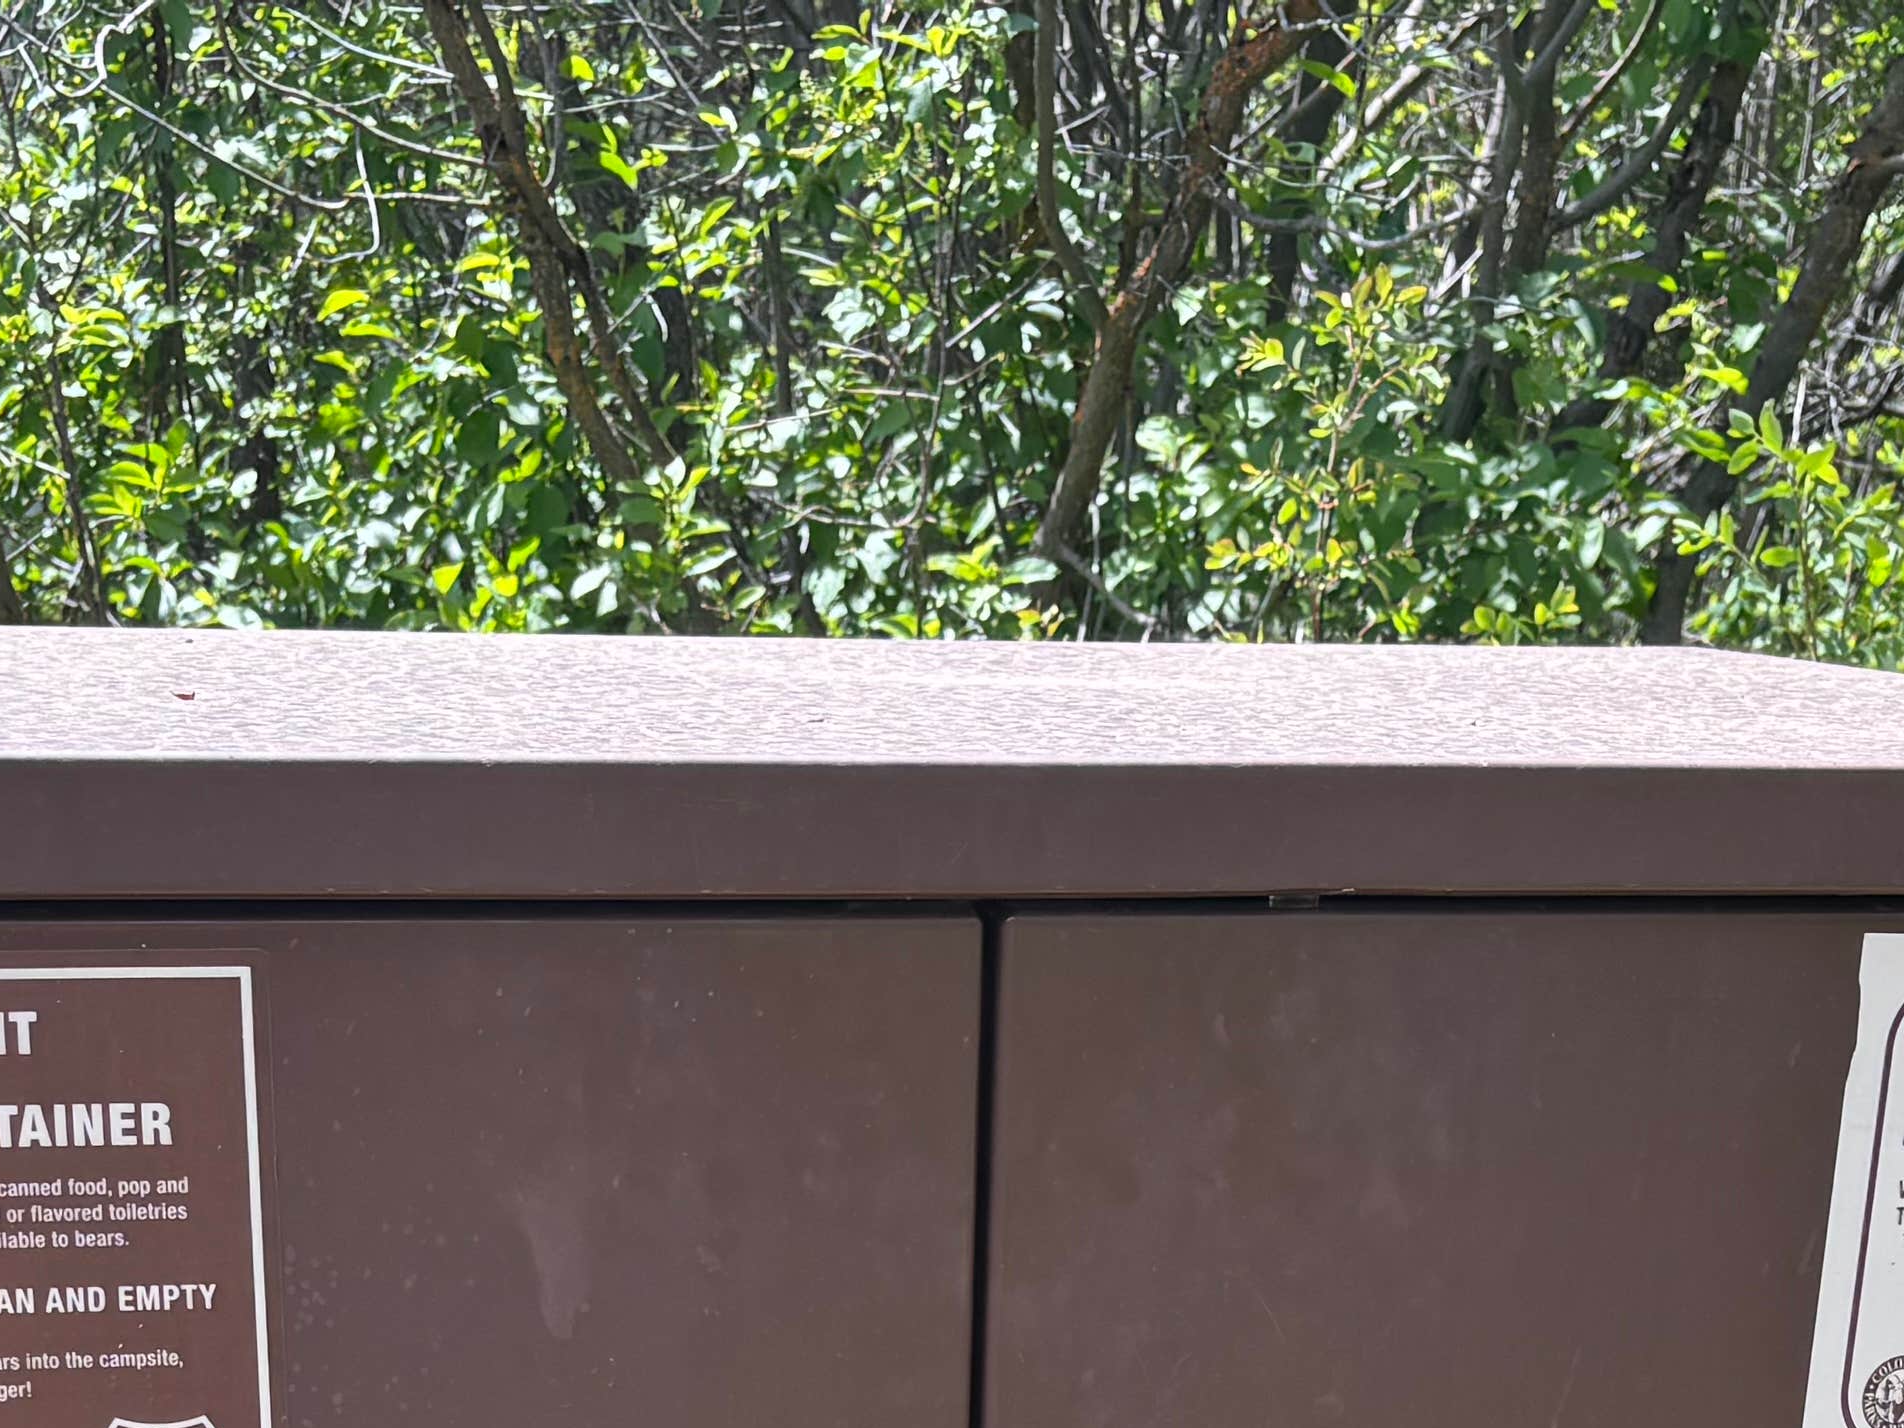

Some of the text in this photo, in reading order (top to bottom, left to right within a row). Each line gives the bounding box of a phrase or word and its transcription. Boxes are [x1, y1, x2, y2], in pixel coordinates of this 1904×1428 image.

[67, 1176, 112, 1197] food,
[117, 1179, 150, 1198] pop
[155, 1175, 188, 1194] and
[5, 1208, 25, 1223] or
[29, 1203, 103, 1222] flavored
[108, 1201, 187, 1220] toiletries
[50, 1230, 68, 1247] to
[74, 1230, 129, 1247] bears.
[45, 1285, 106, 1313] AND
[117, 1282, 216, 1311] EMPTY
[25, 1352, 60, 1369] into
[64, 1351, 93, 1369] the
[98, 1348, 183, 1370] campsite,
